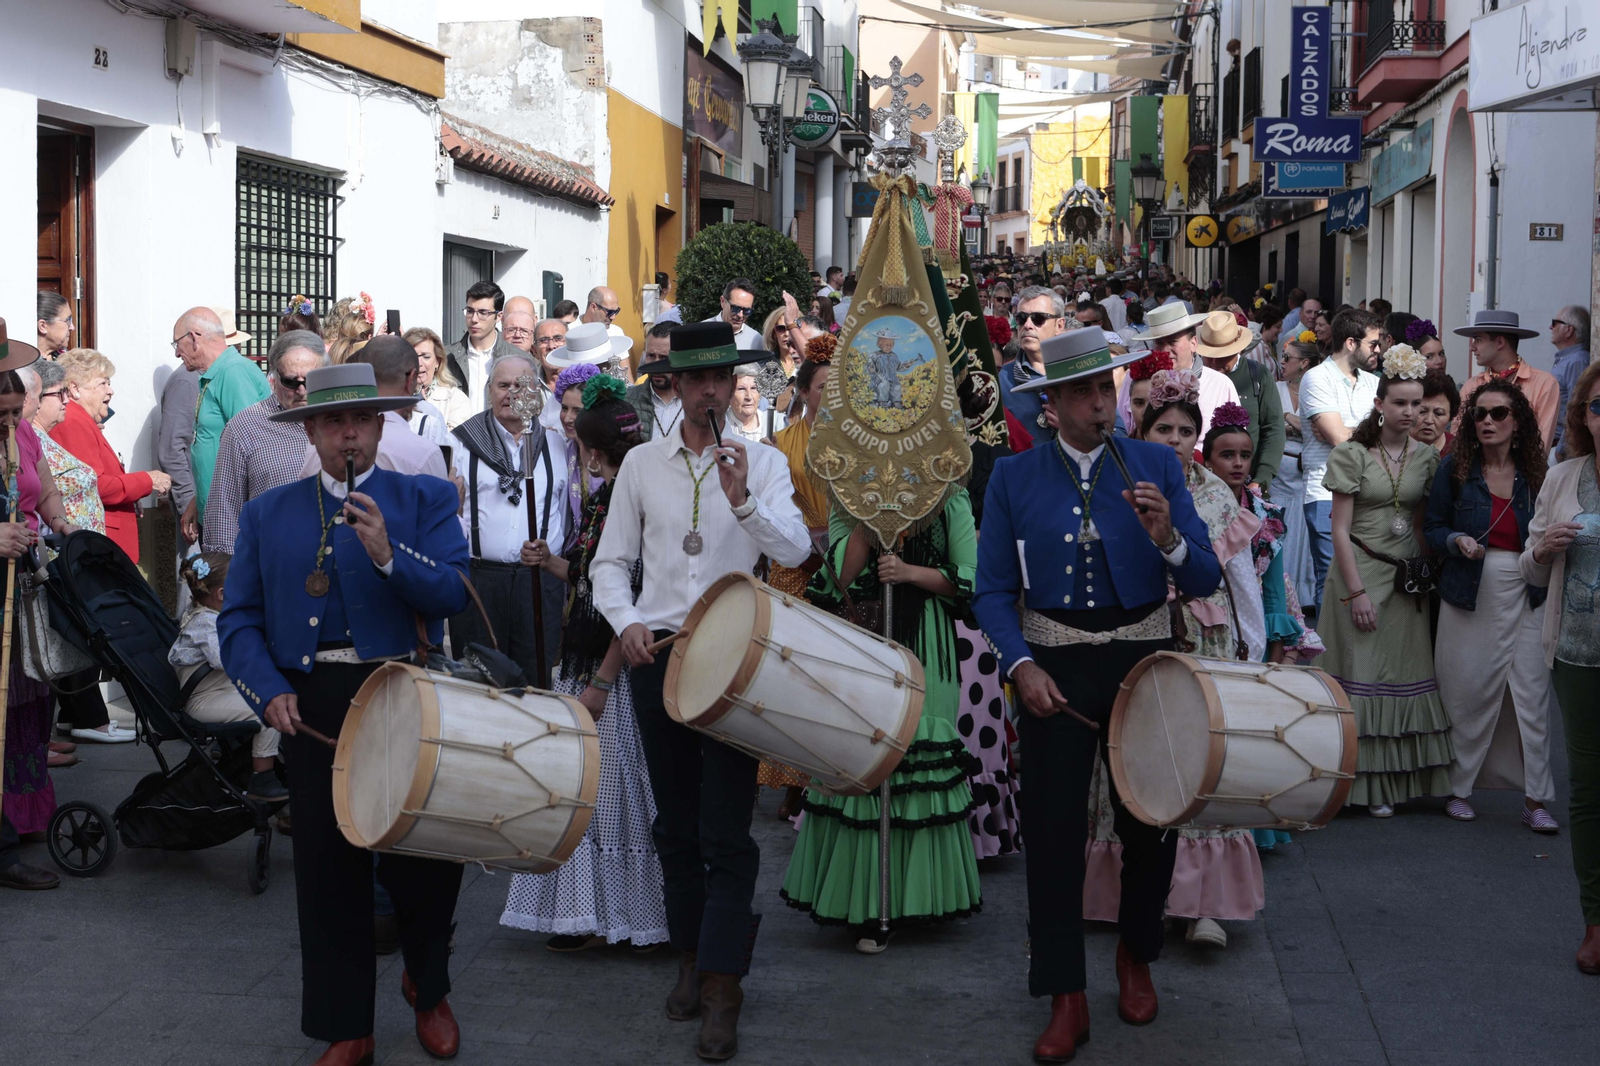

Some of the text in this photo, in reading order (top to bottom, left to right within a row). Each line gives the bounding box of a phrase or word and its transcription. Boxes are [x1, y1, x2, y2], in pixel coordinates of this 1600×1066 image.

[94, 47, 109, 68] 22
[1300, 11, 1320, 117] CALZADOS
[1516, 5, 1587, 89] Alejandra
[1263, 122, 1354, 156] Roma
[698, 350, 721, 360] GINES
[827, 315, 956, 411] HERMANDAD DEL ROCIO
[1075, 356, 1098, 370] GINES
[334, 391, 359, 402] GINES
[841, 418, 942, 456] GRUPO JOVEN
